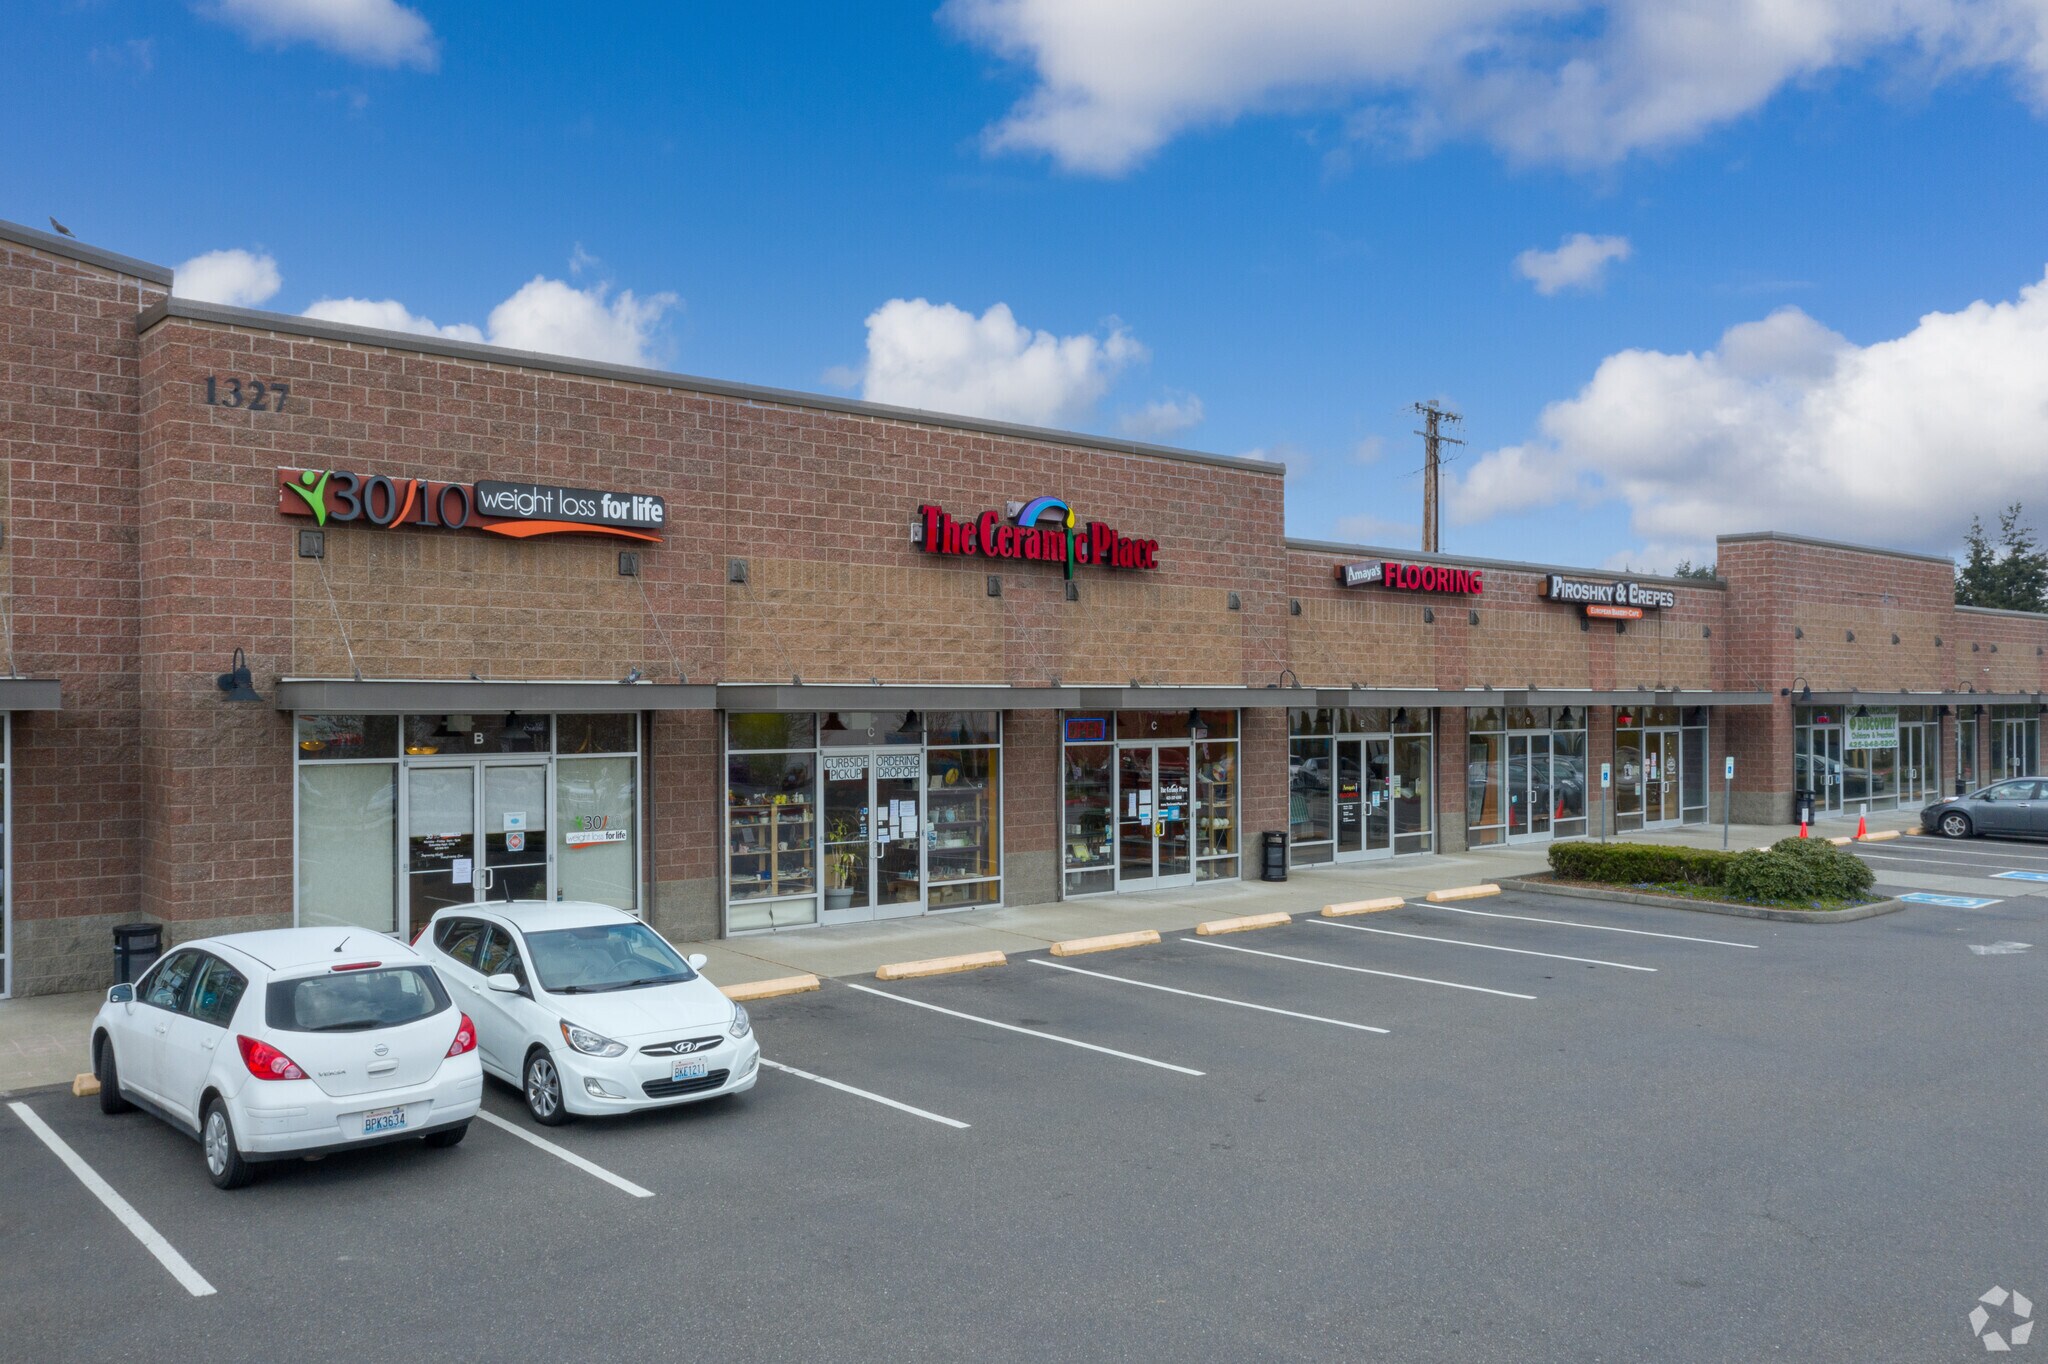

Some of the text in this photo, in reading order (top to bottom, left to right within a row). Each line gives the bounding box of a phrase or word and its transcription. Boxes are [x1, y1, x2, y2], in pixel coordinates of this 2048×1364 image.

[204, 375, 290, 413] 1327
[329, 470, 663, 530] 30/10 weight loss for life
[920, 504, 977, 555] The
[1088, 521, 1159, 569] Place
[1347, 562, 1483, 595] Amaya's FLOORING
[1551, 576, 1674, 608] PIROSHKY & CREPES
[1151, 721, 1158, 730] C
[1360, 720, 1365, 728] E
[1857, 717, 1896, 730] DISCOVERY
[868, 727, 875, 737] C
[1067, 722, 1103, 739] OPEN
[474, 733, 484, 744] B
[825, 757, 869, 769] CURBSIDE
[876, 755, 920, 767] ORDERING
[830, 768, 862, 780] PICKUP
[878, 766, 919, 778] DROP OFF
[605, 831, 615, 840] for
[615, 830, 626, 839] life
[675, 1063, 705, 1078] BKE1211
[365, 1113, 405, 1131] BPK3634
